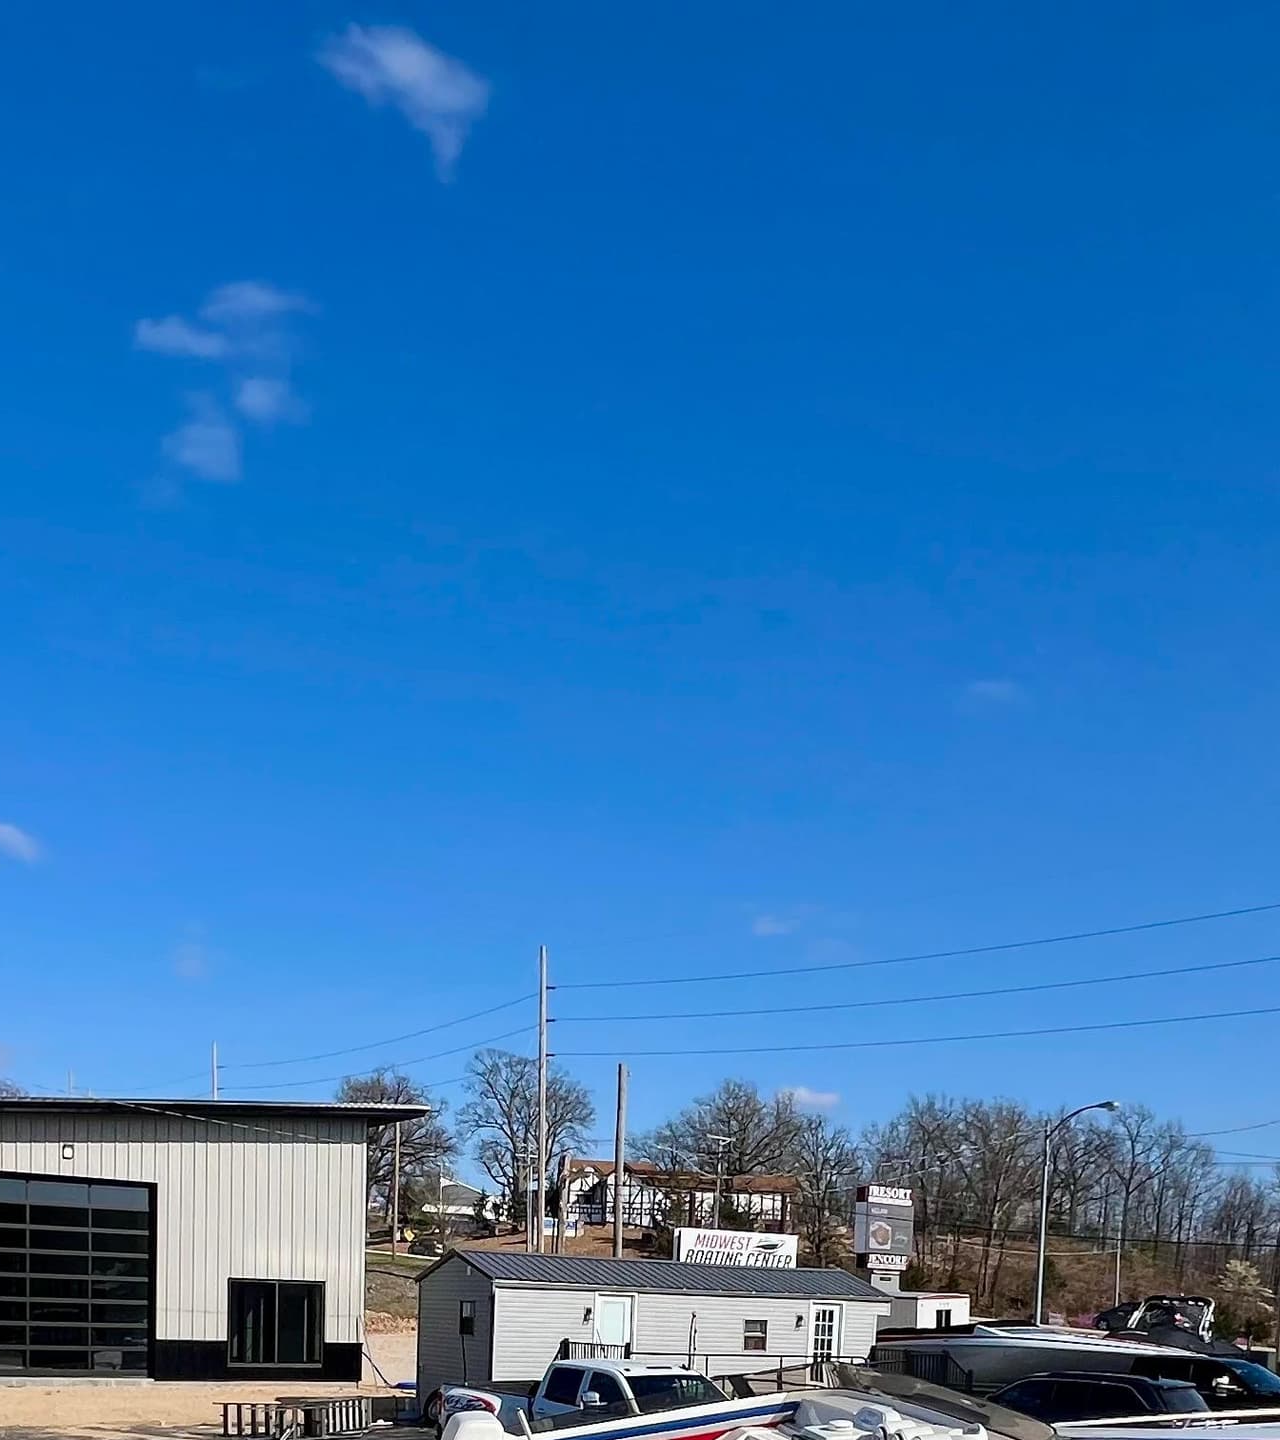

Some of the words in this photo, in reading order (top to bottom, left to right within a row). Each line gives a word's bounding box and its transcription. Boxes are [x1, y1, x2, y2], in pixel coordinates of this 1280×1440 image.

[694, 1233, 752, 1251] MIDWEST
[685, 1248, 743, 1267] BOATING
[745, 1252, 793, 1268] CENTER
